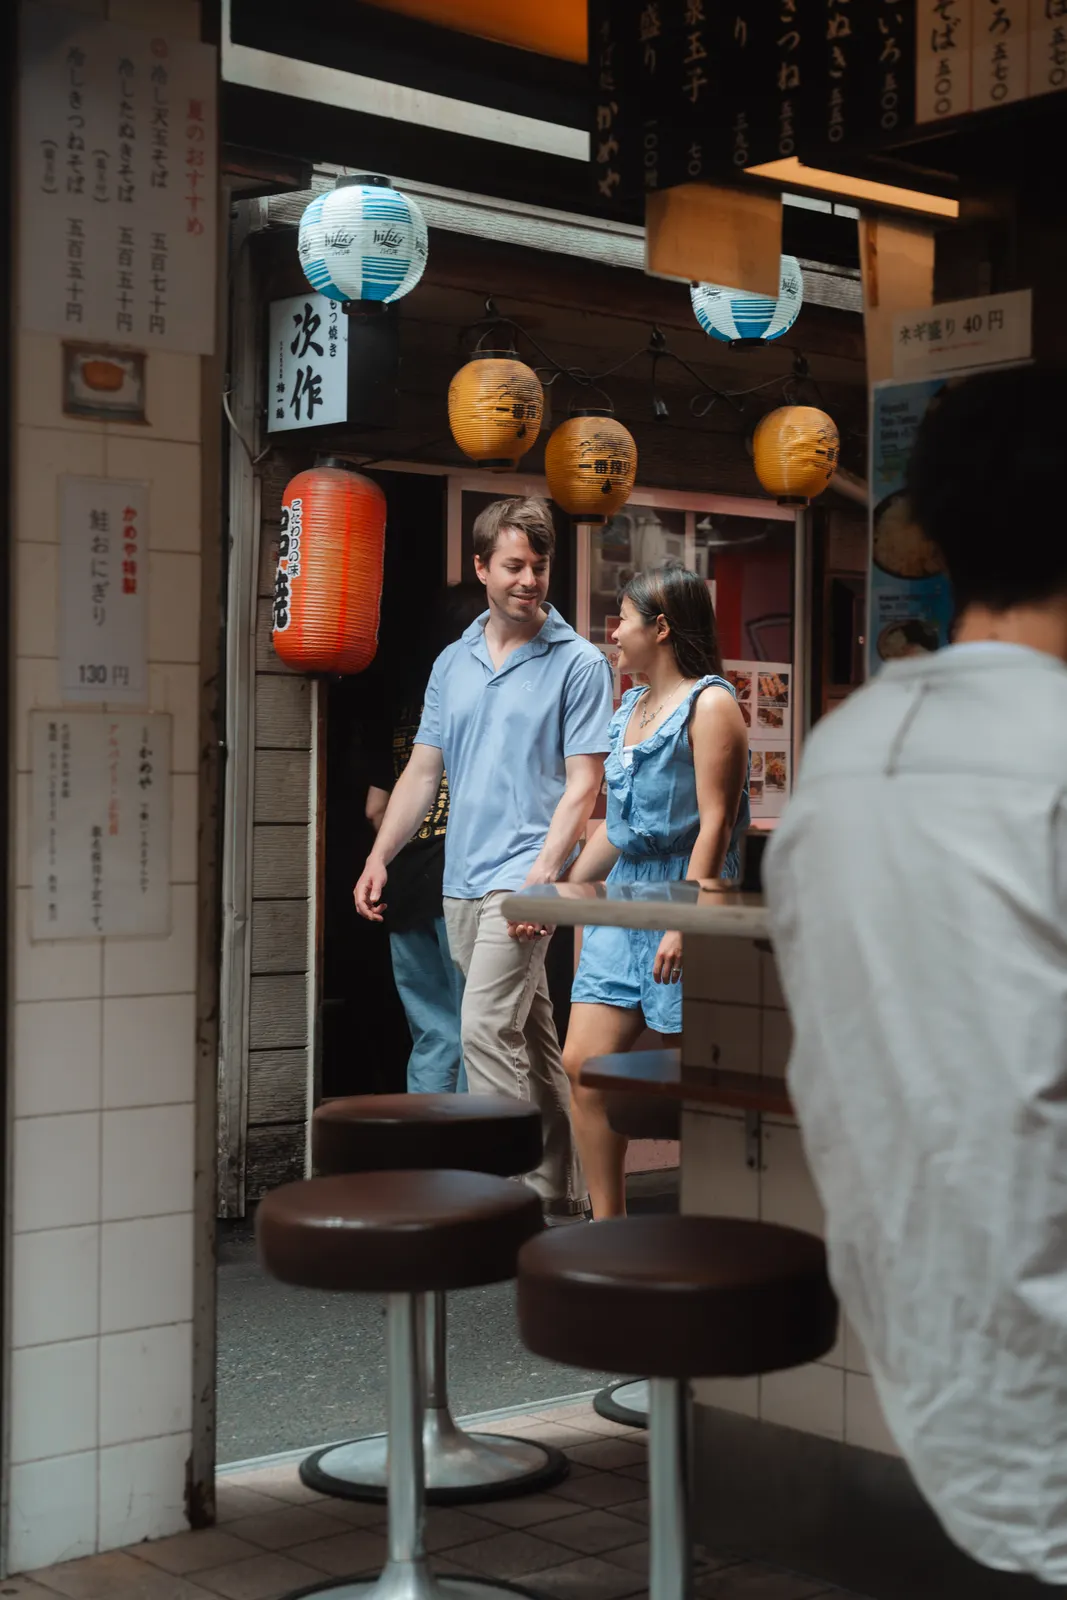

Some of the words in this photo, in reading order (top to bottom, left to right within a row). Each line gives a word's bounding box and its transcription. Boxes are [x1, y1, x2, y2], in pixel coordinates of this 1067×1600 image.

[826, 0, 852, 78] ぬき
[185, 98, 205, 236] 夏のおすすめ
[963, 314, 982, 334] 40
[988, 309, 1004, 332] 円
[290, 302, 324, 421] 次作
[287, 499, 302, 577] こだわりの味
[79, 664, 107, 684] 130
[112, 665, 129, 686] 円
